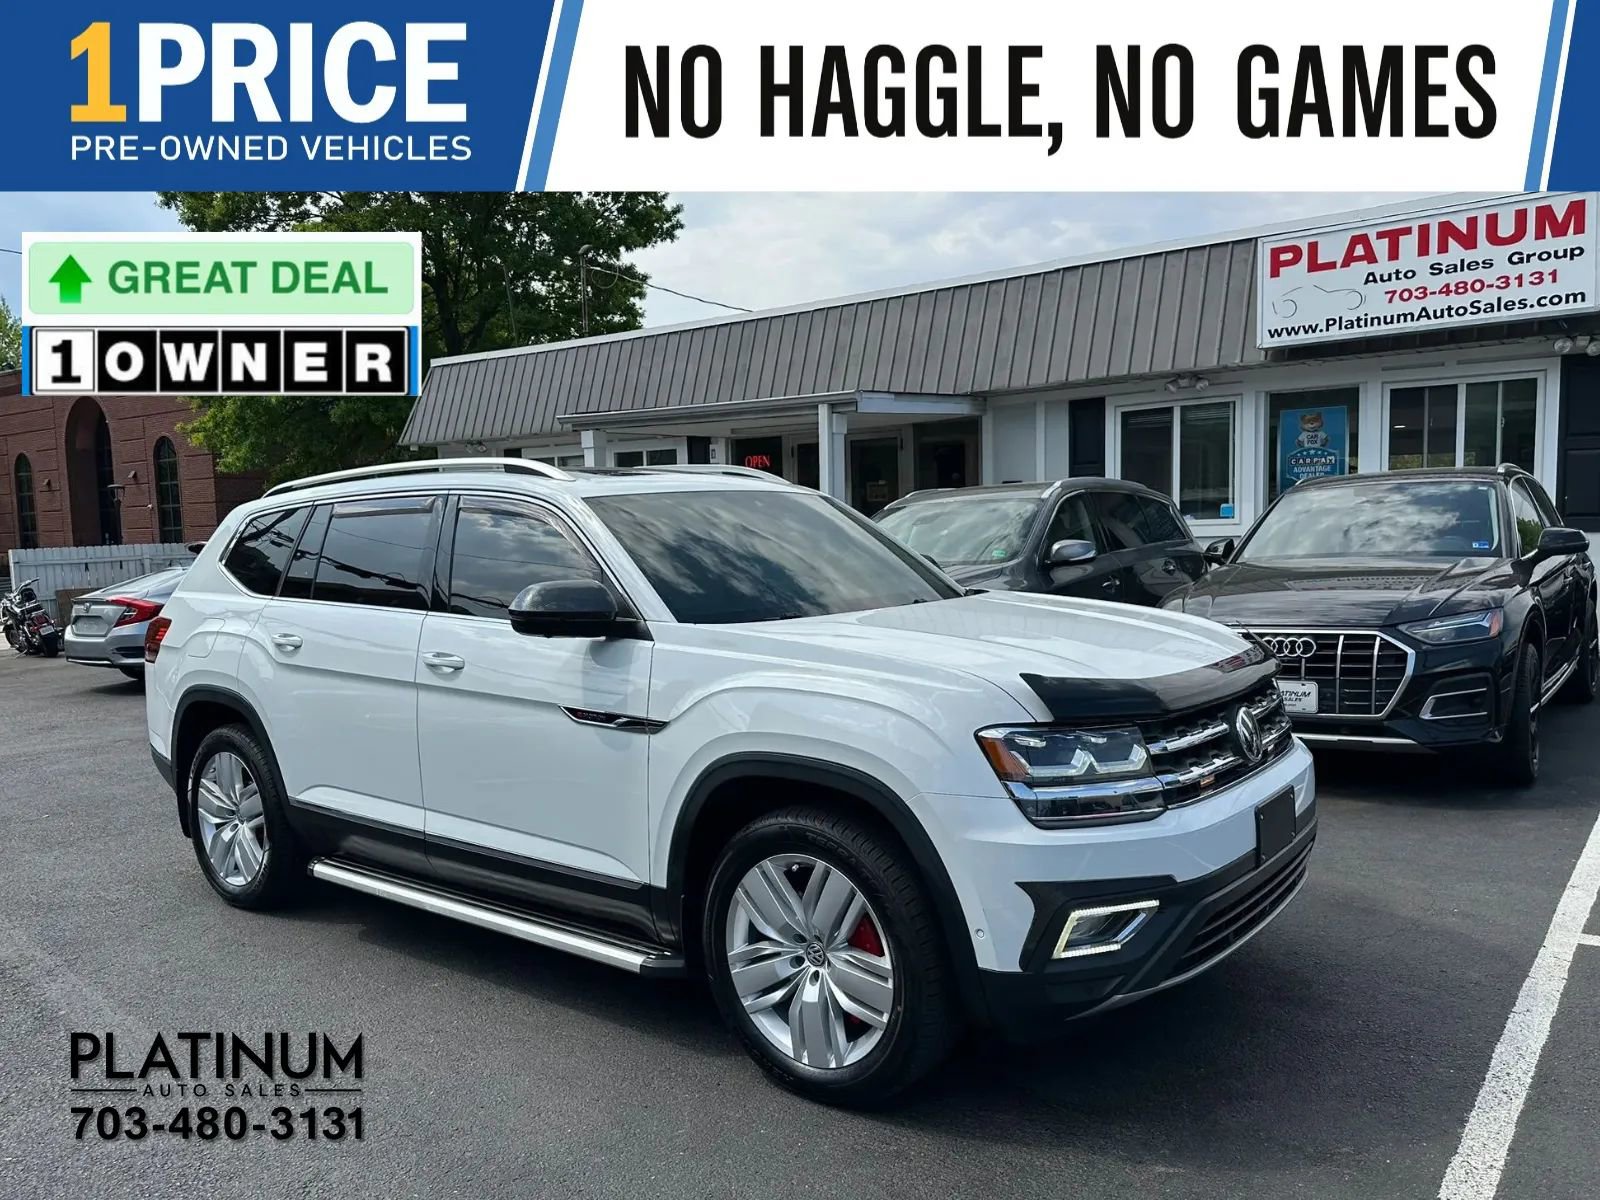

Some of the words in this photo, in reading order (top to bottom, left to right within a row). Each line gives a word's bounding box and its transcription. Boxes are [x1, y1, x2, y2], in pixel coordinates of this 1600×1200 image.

[1269, 199, 1586, 278] PLATINUM
[1363, 268, 1417, 285] Auto
[1428, 257, 1494, 276] Sales
[1507, 245, 1585, 266] Group
[1384, 268, 1558, 304] 703-480-3131
[1267, 290, 1586, 340] www.PlatinumAutoSales.com
[744, 455, 771, 468] OPEN
[1293, 465, 1331, 473] ADVANTAGE
